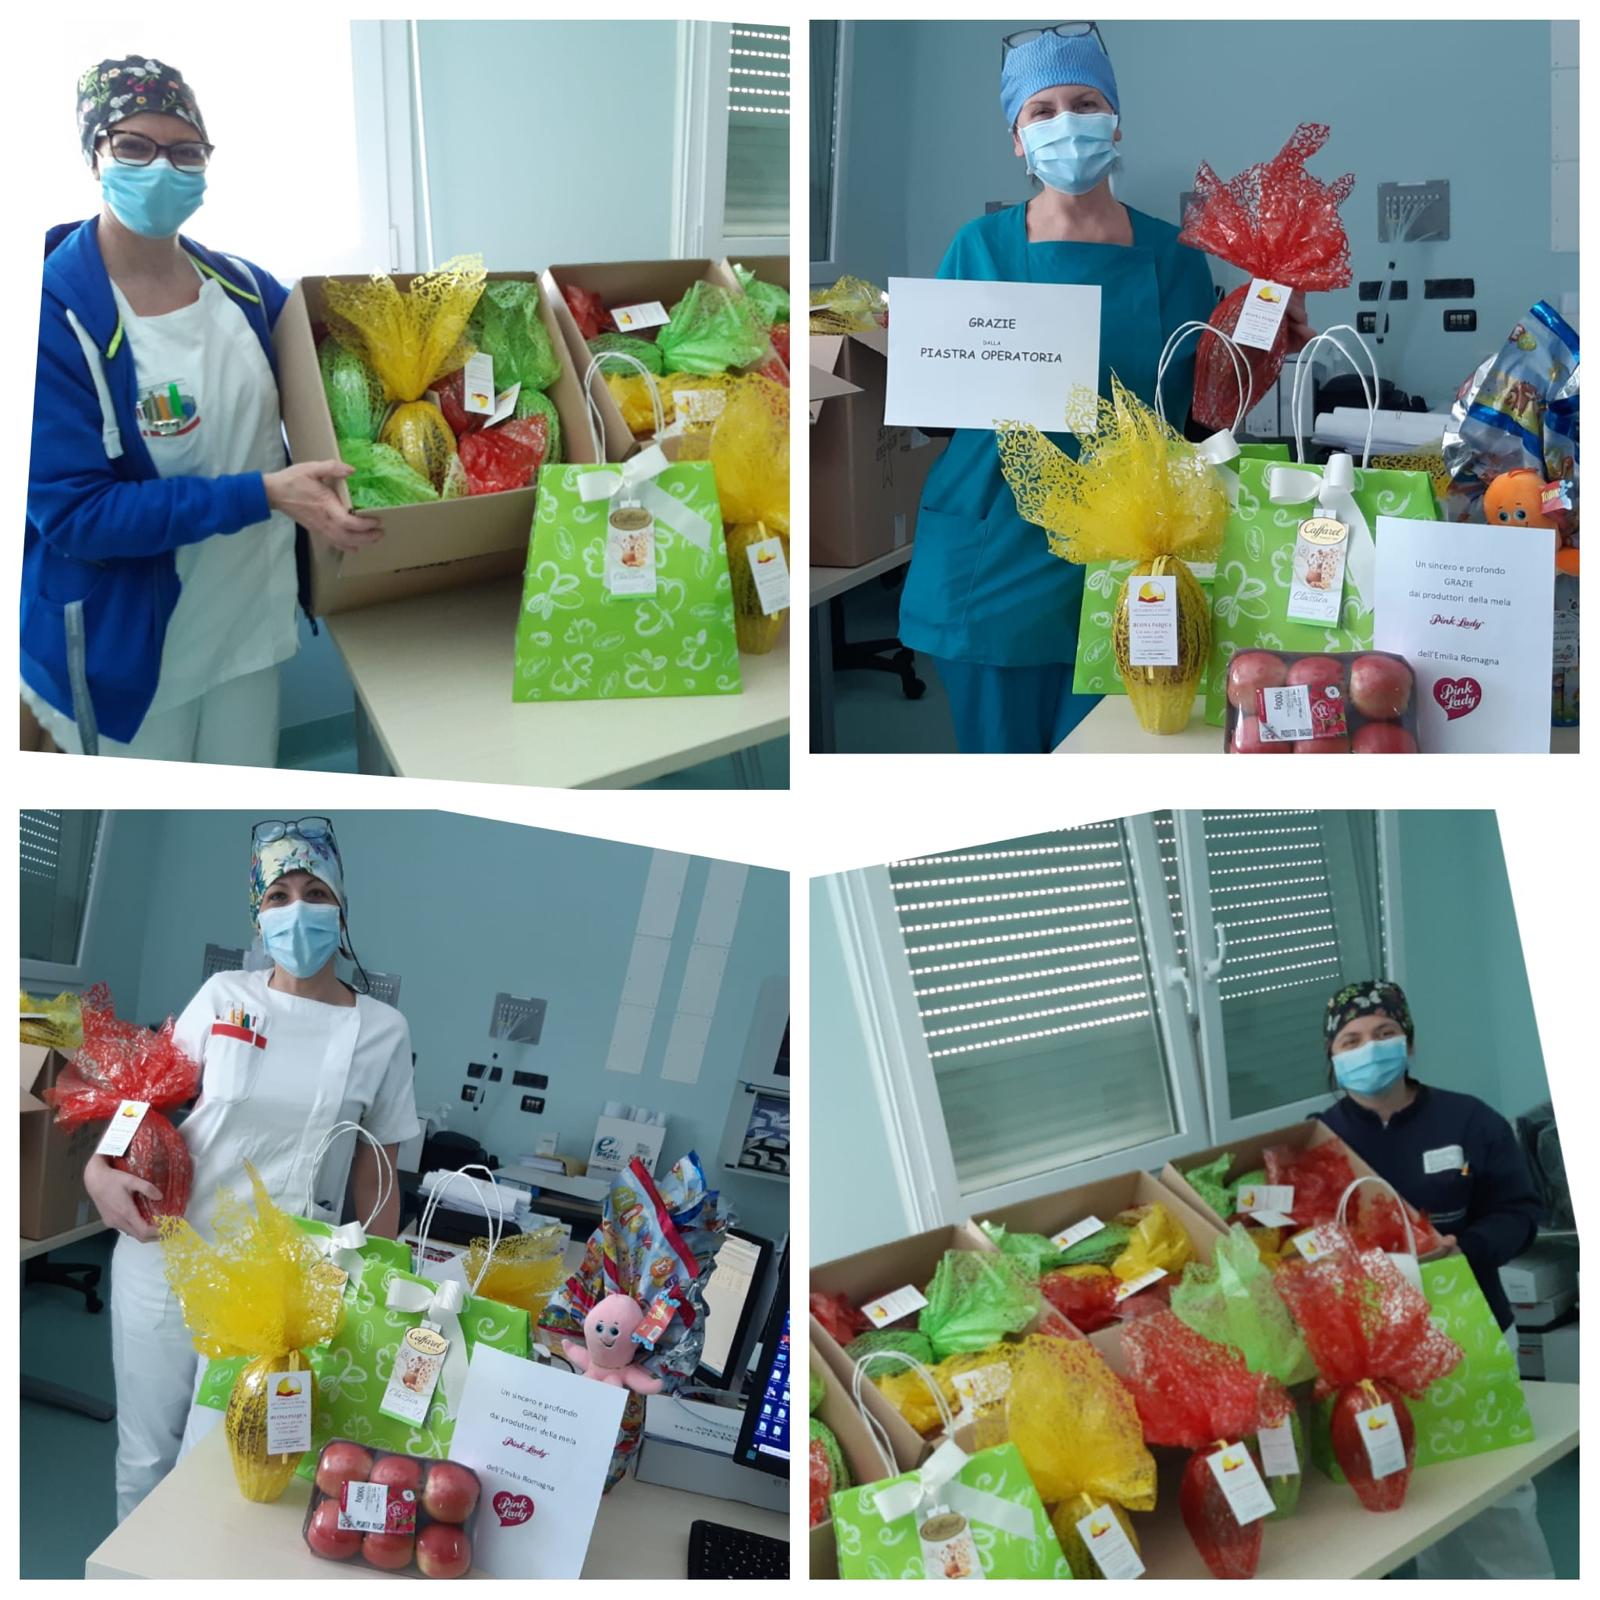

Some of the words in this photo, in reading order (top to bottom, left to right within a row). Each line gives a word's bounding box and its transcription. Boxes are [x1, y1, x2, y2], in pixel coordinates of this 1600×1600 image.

[968, 317, 1016, 330] GRAZIE
[920, 347, 976, 360] PIASTRA
[981, 350, 1063, 363] OPERATORIA
[1304, 521, 1344, 537] Caffarel
[1415, 559, 1426, 568] Un
[1428, 561, 1457, 571] sincero
[1466, 565, 1506, 575] profondo
[1444, 578, 1473, 587] GRAZIE
[1408, 590, 1421, 598] dai
[1422, 591, 1464, 602] produttori
[1468, 596, 1488, 604] della
[1490, 597, 1511, 606] mela
[1429, 613, 1456, 625] Pink
[1456, 616, 1482, 630] Lady
[1417, 649, 1459, 661] dell'Emilia
[1460, 654, 1500, 666] Romagna
[1440, 681, 1473, 699] Pink
[1445, 694, 1476, 710] Lady
[409, 1330, 445, 1350] Caffarel
[501, 1388, 511, 1397] Un
[512, 1393, 537, 1405] sincero
[544, 1403, 578, 1418] profondo
[522, 1409, 548, 1422] GRAZIE
[501, 1416, 537, 1432] produttori
[540, 1428, 557, 1440] della
[558, 1435, 577, 1445] mela
[502, 1436, 526, 1450] Pink
[525, 1445, 547, 1458] Lady
[522, 1475, 555, 1492] Romagna
[498, 1497, 528, 1509] Pink
[500, 1506, 528, 1520] Lady
